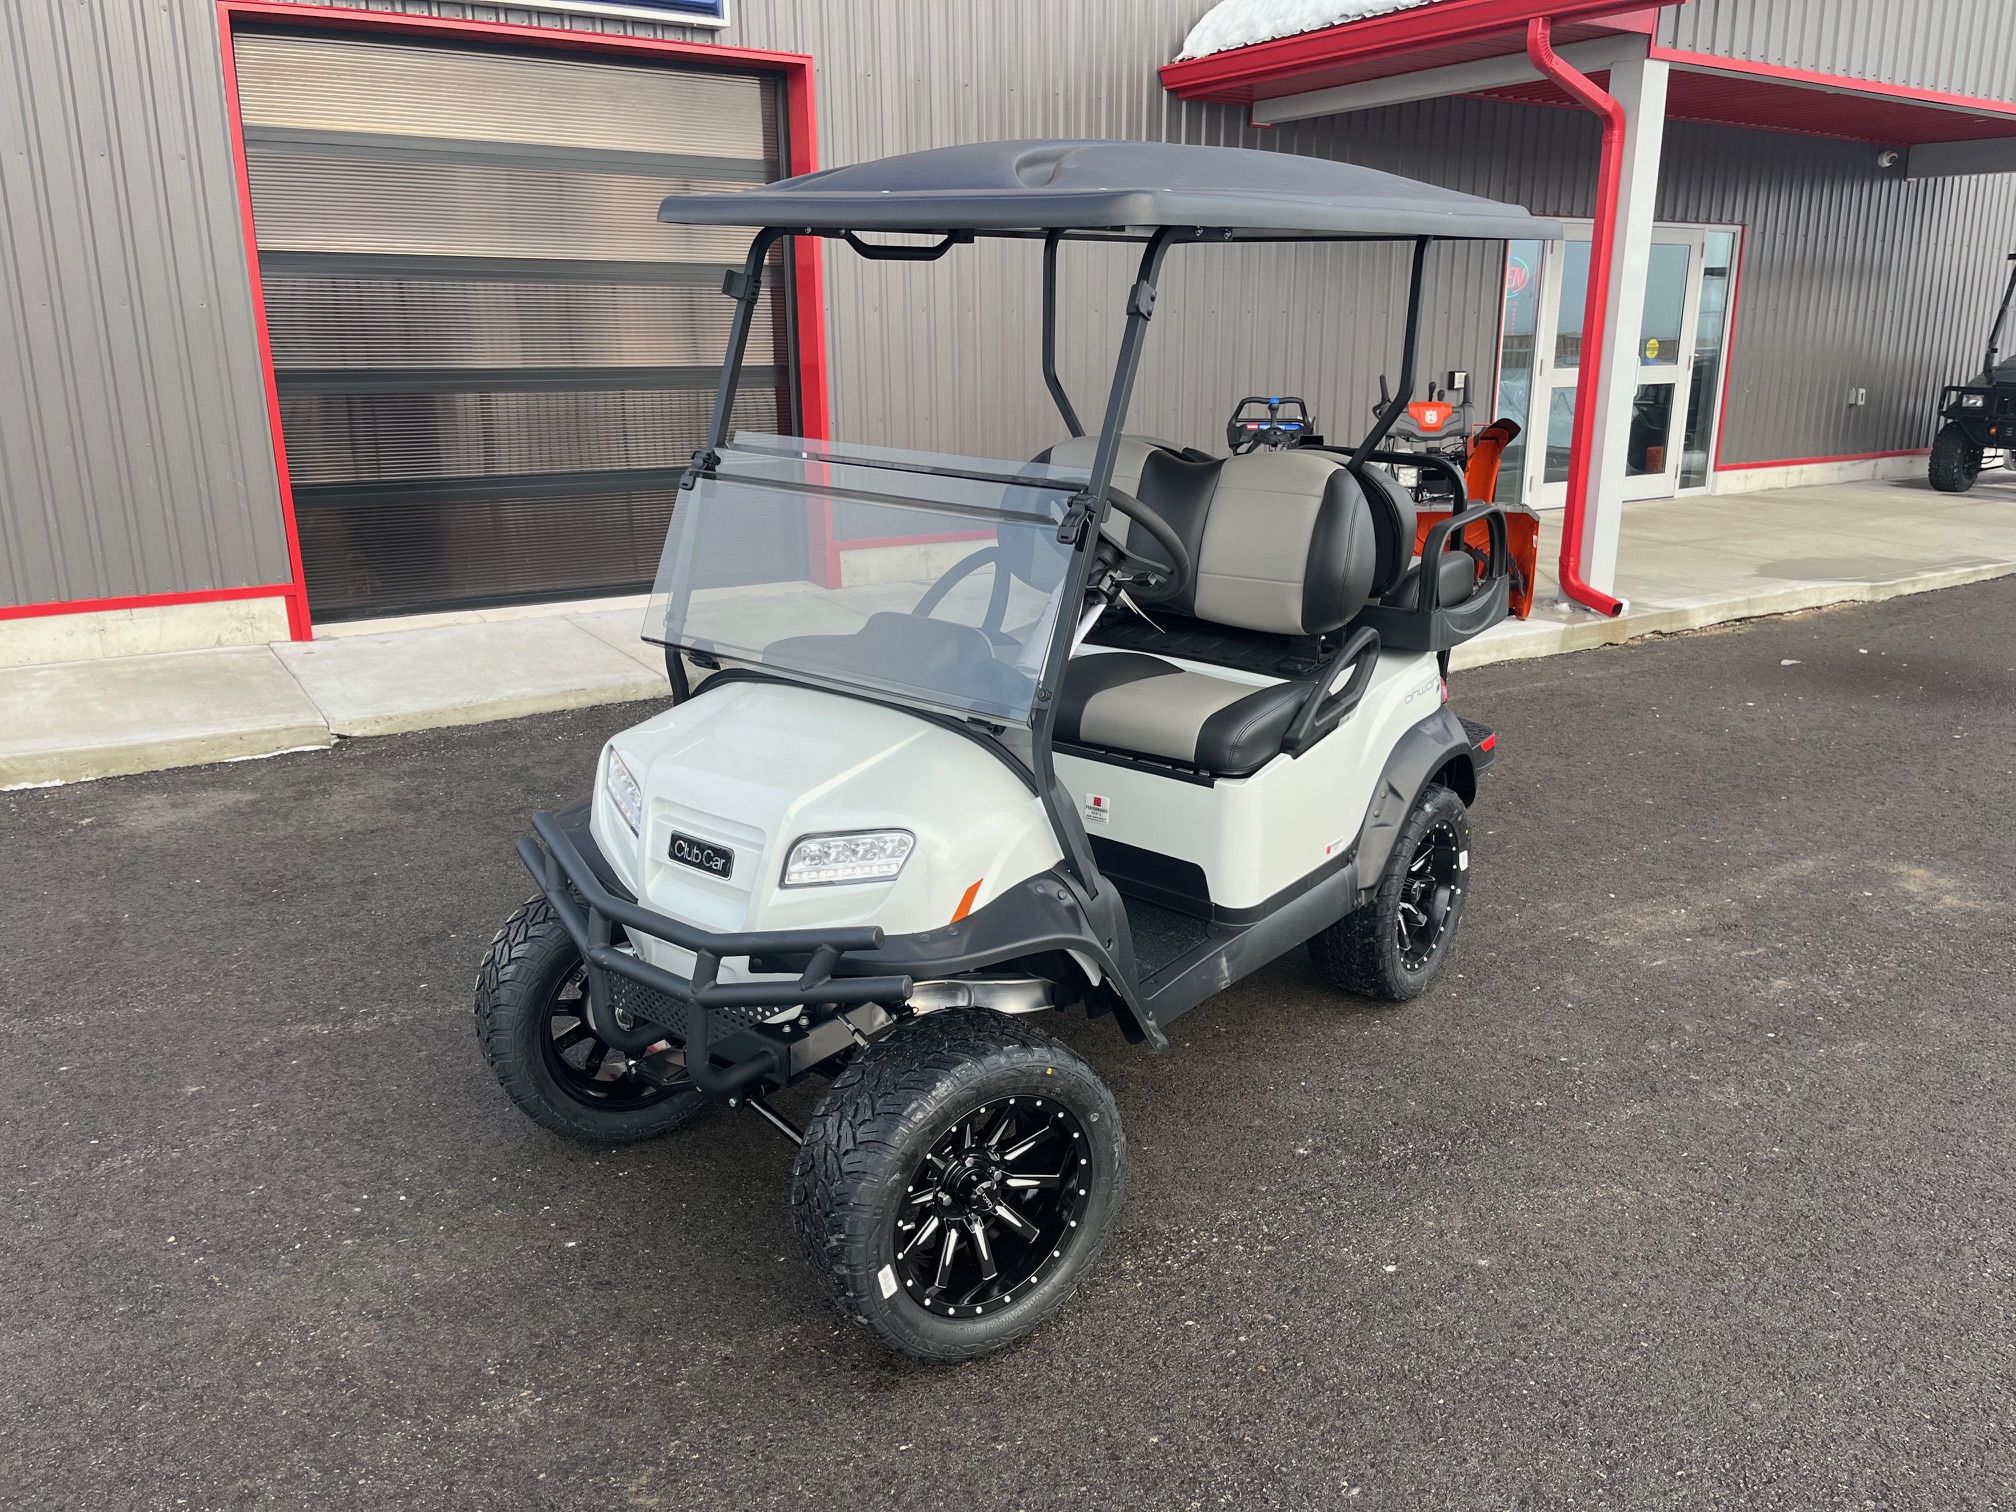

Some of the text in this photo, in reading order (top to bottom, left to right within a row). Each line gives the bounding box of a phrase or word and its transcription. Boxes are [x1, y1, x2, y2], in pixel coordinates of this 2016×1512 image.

[1506, 267, 1526, 288] EN
[674, 840, 726, 871] Club Car
